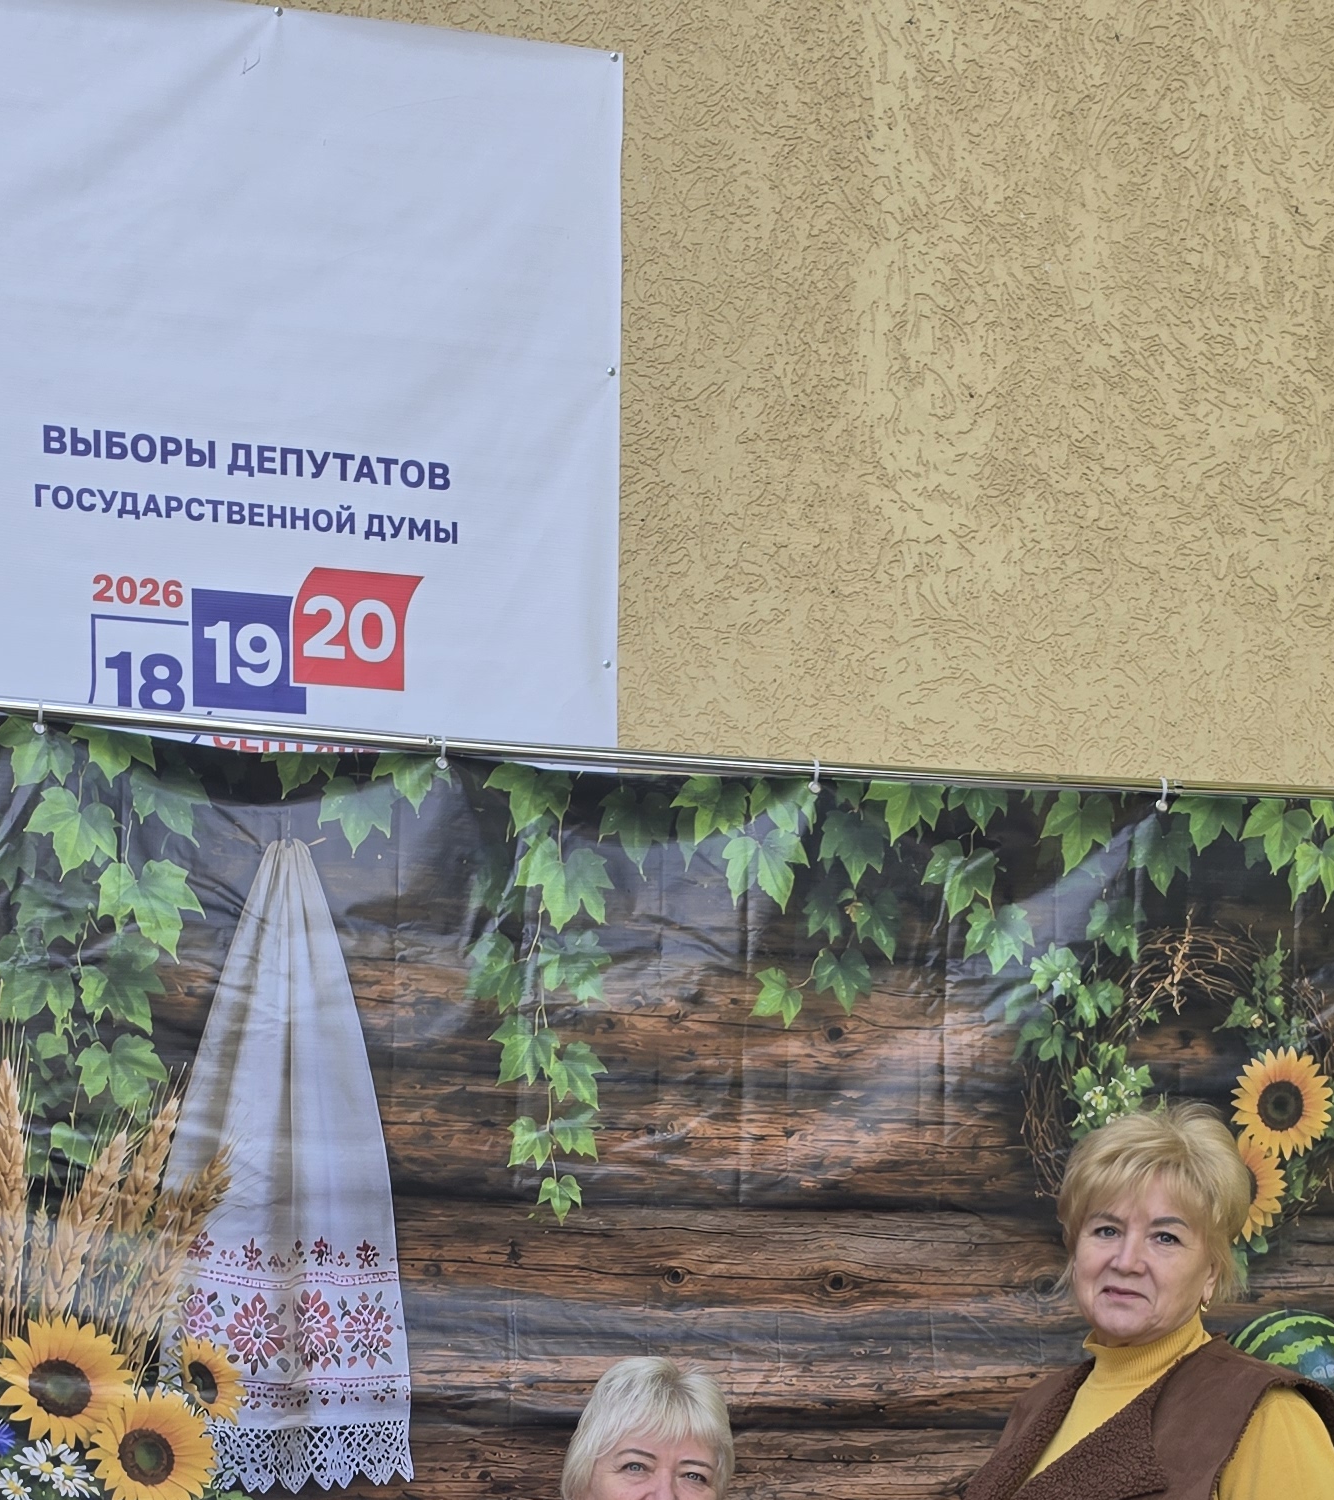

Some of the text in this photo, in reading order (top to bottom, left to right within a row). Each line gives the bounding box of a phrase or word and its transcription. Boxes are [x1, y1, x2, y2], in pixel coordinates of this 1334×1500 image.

[42, 424, 451, 491] ВЫБОРЫ ДЕПУТАТОВ
[34, 483, 458, 545] ГОСУДАРСТВЕННОЙ ДУМЫ
[92, 574, 184, 608] 2026
[104, 594, 398, 712] 18 19 20
